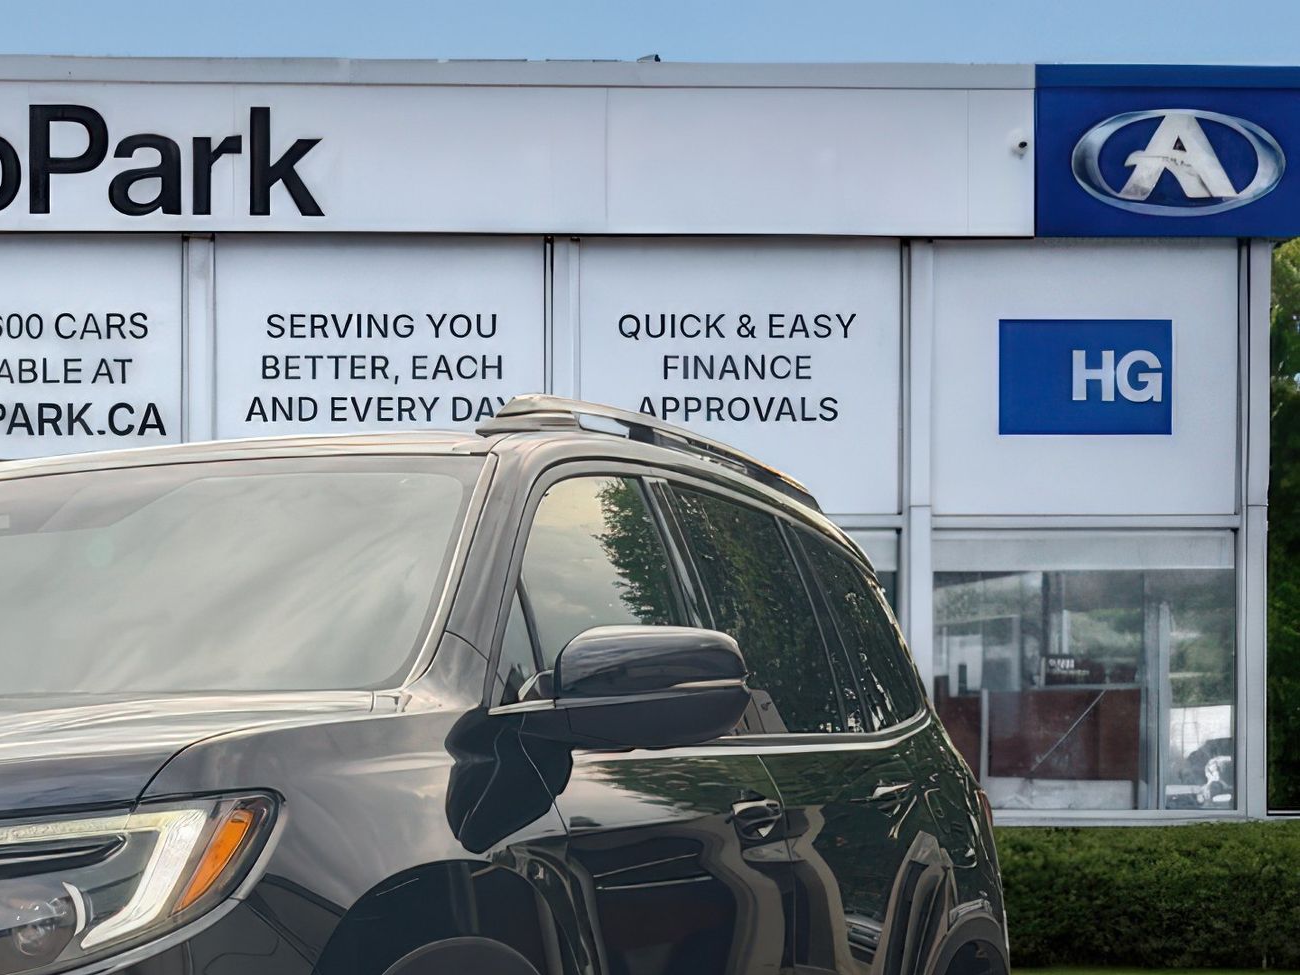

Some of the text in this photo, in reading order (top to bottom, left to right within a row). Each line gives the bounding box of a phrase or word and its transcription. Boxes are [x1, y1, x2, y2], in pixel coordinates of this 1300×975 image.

[54, 312, 149, 340] CARS
[266, 313, 497, 339] SERVING YOU
[618, 313, 857, 341] QUICK & EASY
[91, 357, 133, 385] AT
[261, 354, 503, 385] BETTER, EACH
[663, 354, 812, 381] FINANCE
[1072, 350, 1163, 402] HG
[245, 396, 318, 423] AND
[330, 396, 440, 423] EVERY
[638, 396, 839, 423] APPROVALS
